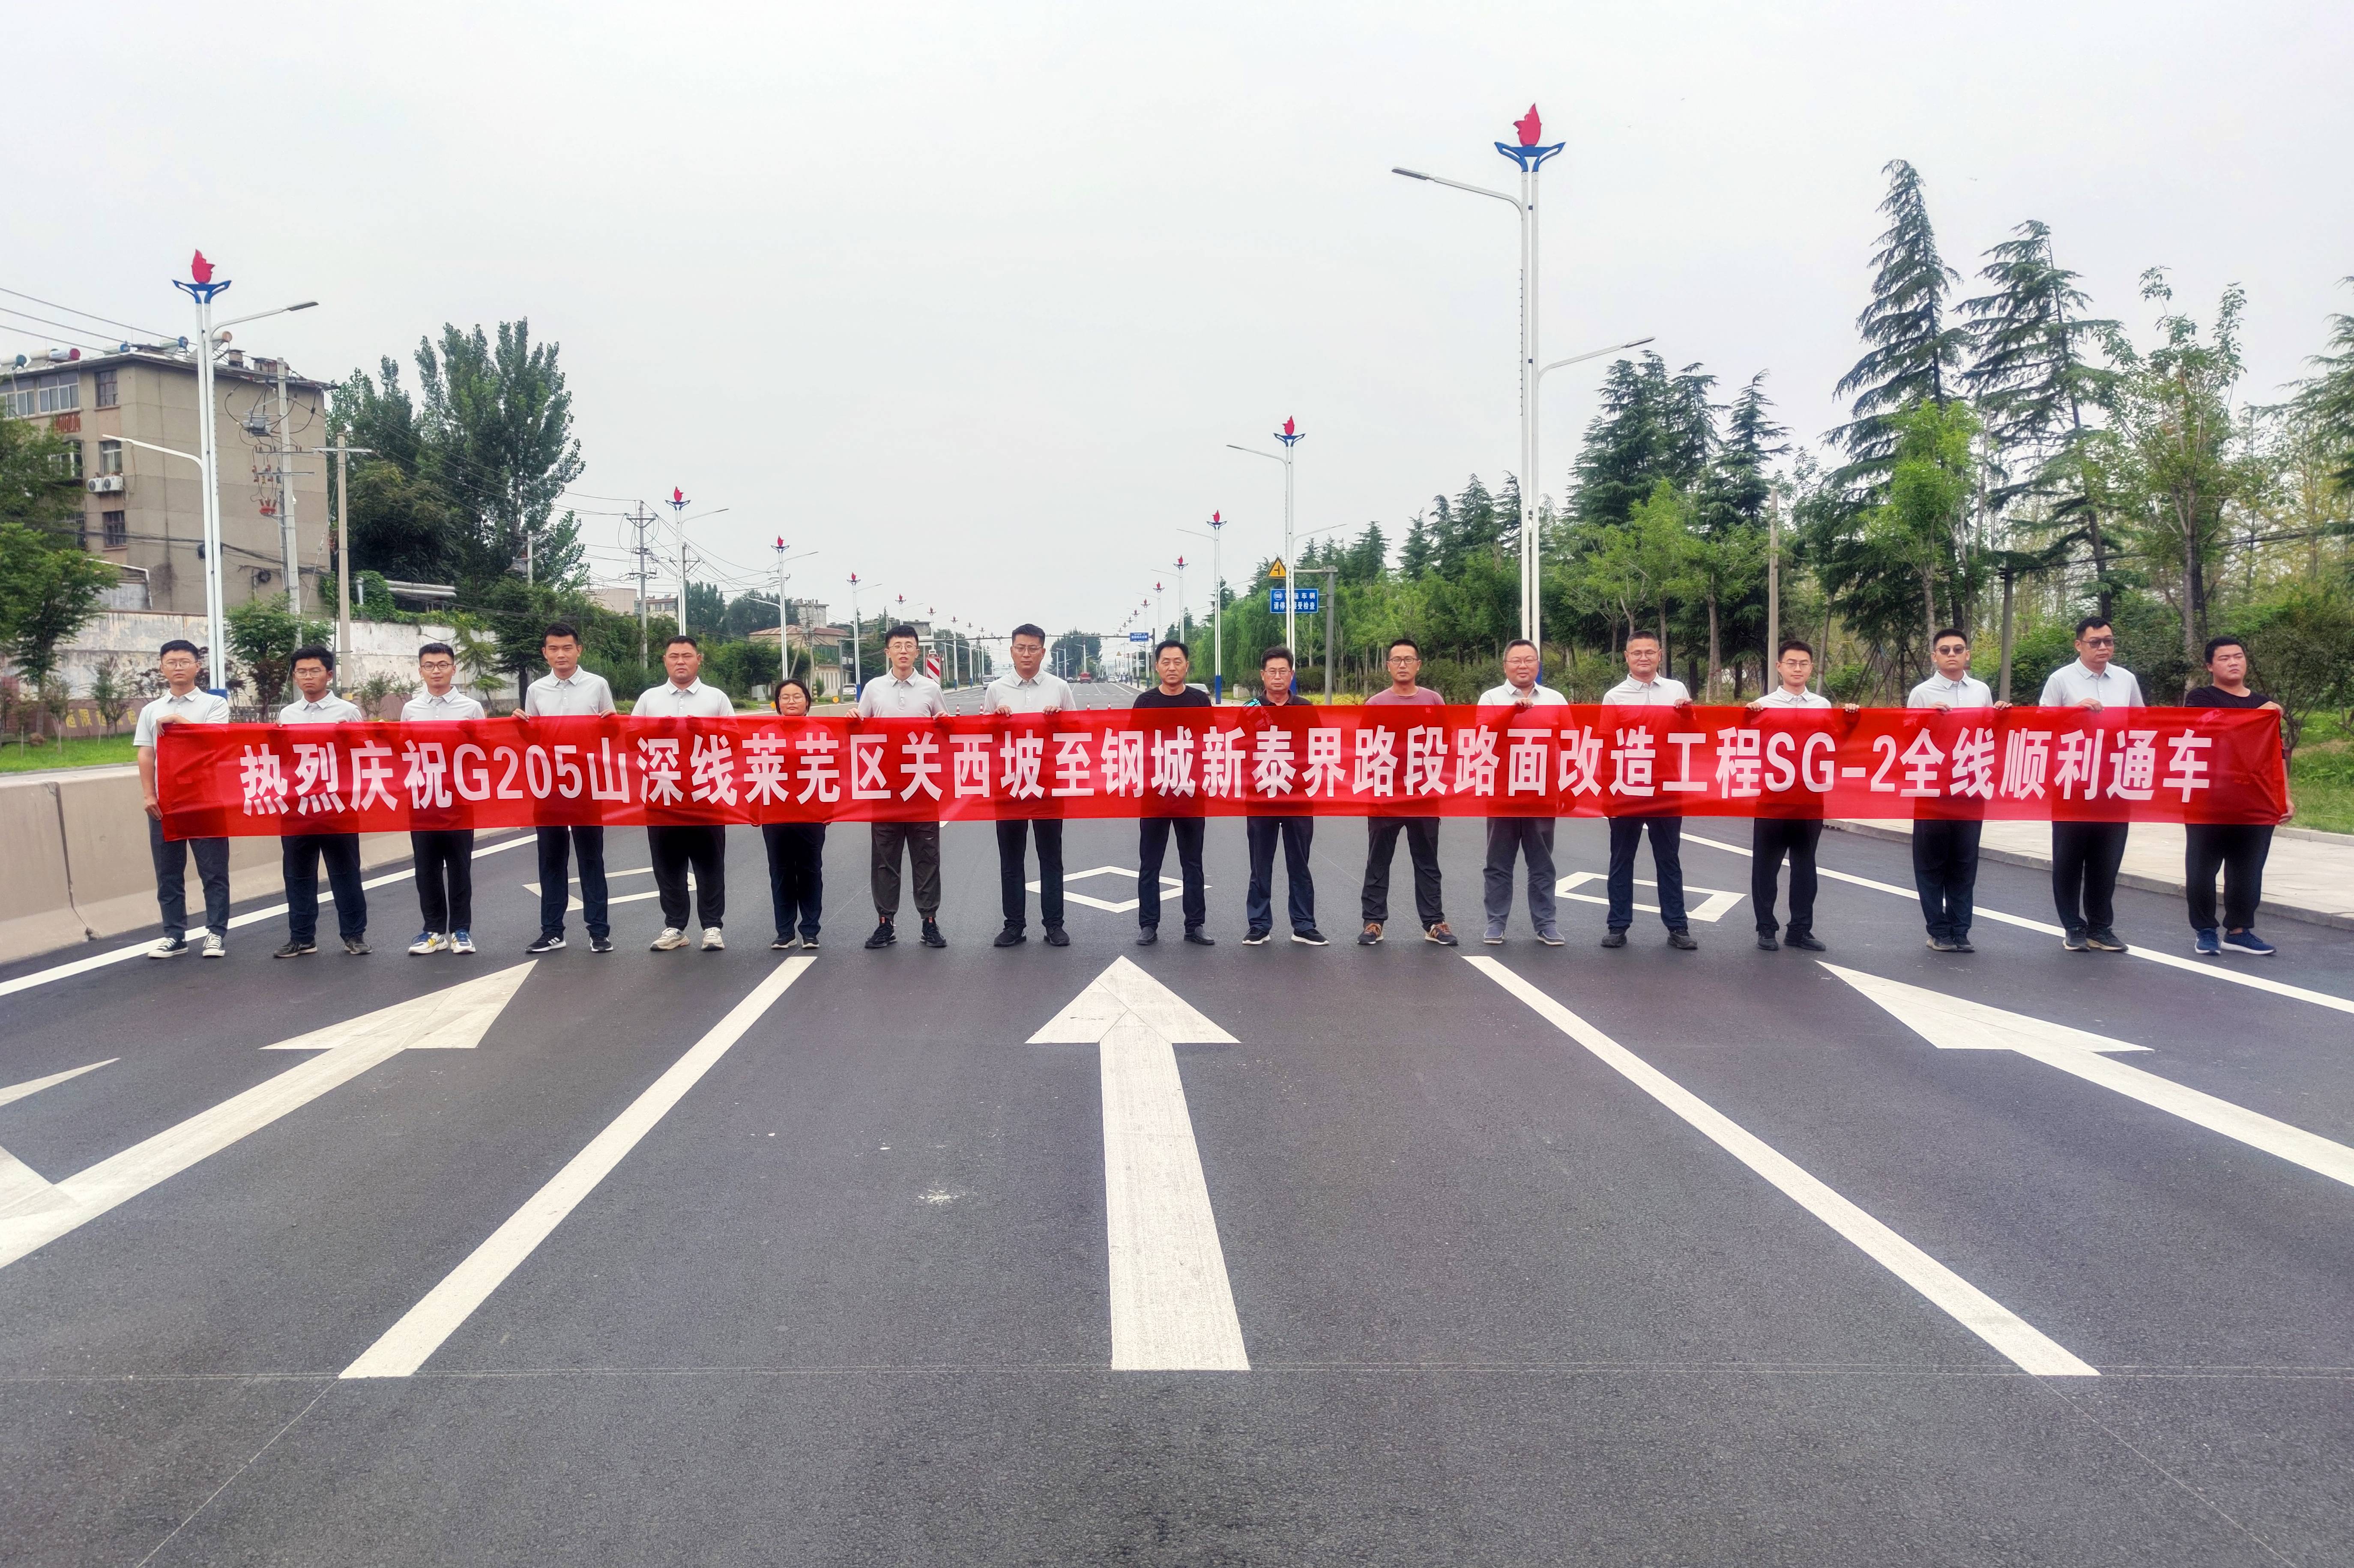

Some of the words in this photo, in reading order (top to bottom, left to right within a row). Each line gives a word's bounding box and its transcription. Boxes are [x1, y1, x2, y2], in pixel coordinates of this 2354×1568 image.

[239, 724, 2213, 816] 热烈庆祝G205山深线莱芜区关西坡至钢城新泰界路段路面改造工程SG-2全线顺利通车
